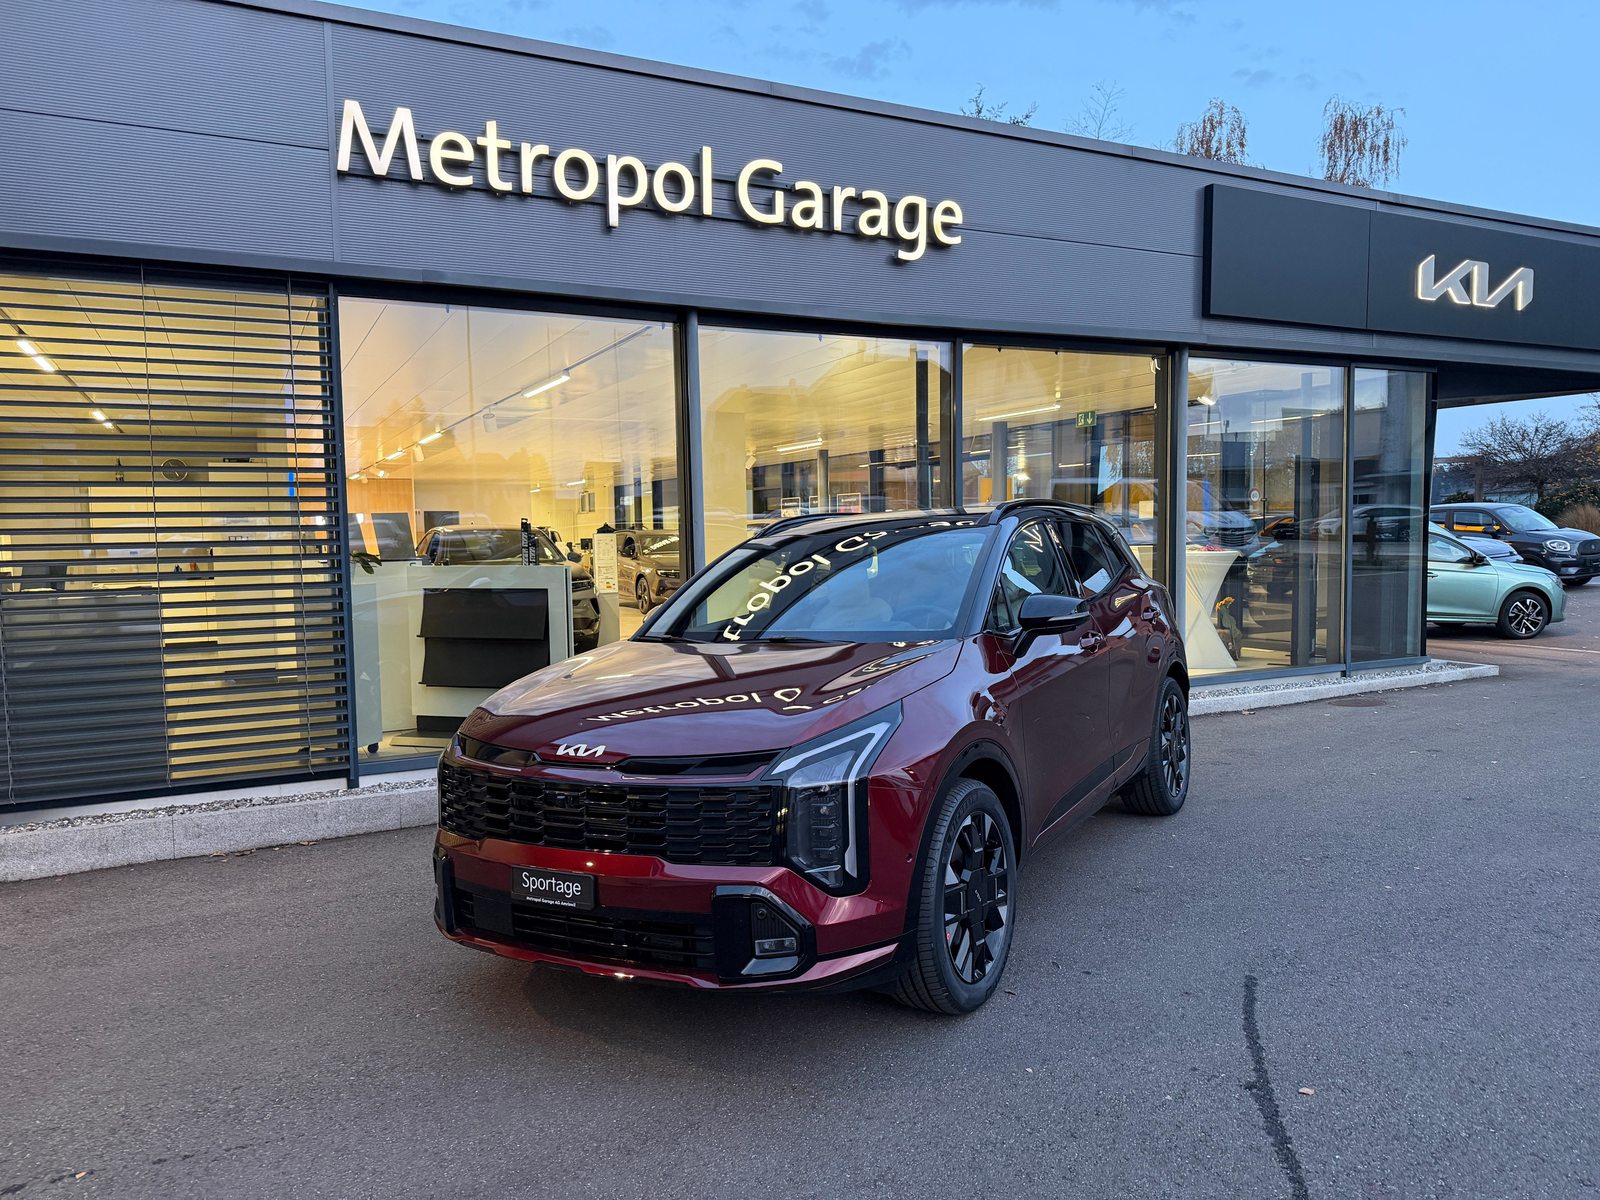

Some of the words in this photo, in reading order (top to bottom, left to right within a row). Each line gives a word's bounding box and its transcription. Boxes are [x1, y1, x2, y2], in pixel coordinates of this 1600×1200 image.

[337, 99, 713, 229] Metropol
[736, 158, 964, 262] Garage
[1416, 254, 1535, 312] KIA
[556, 743, 607, 758] KIA
[521, 871, 582, 898] Sportage
